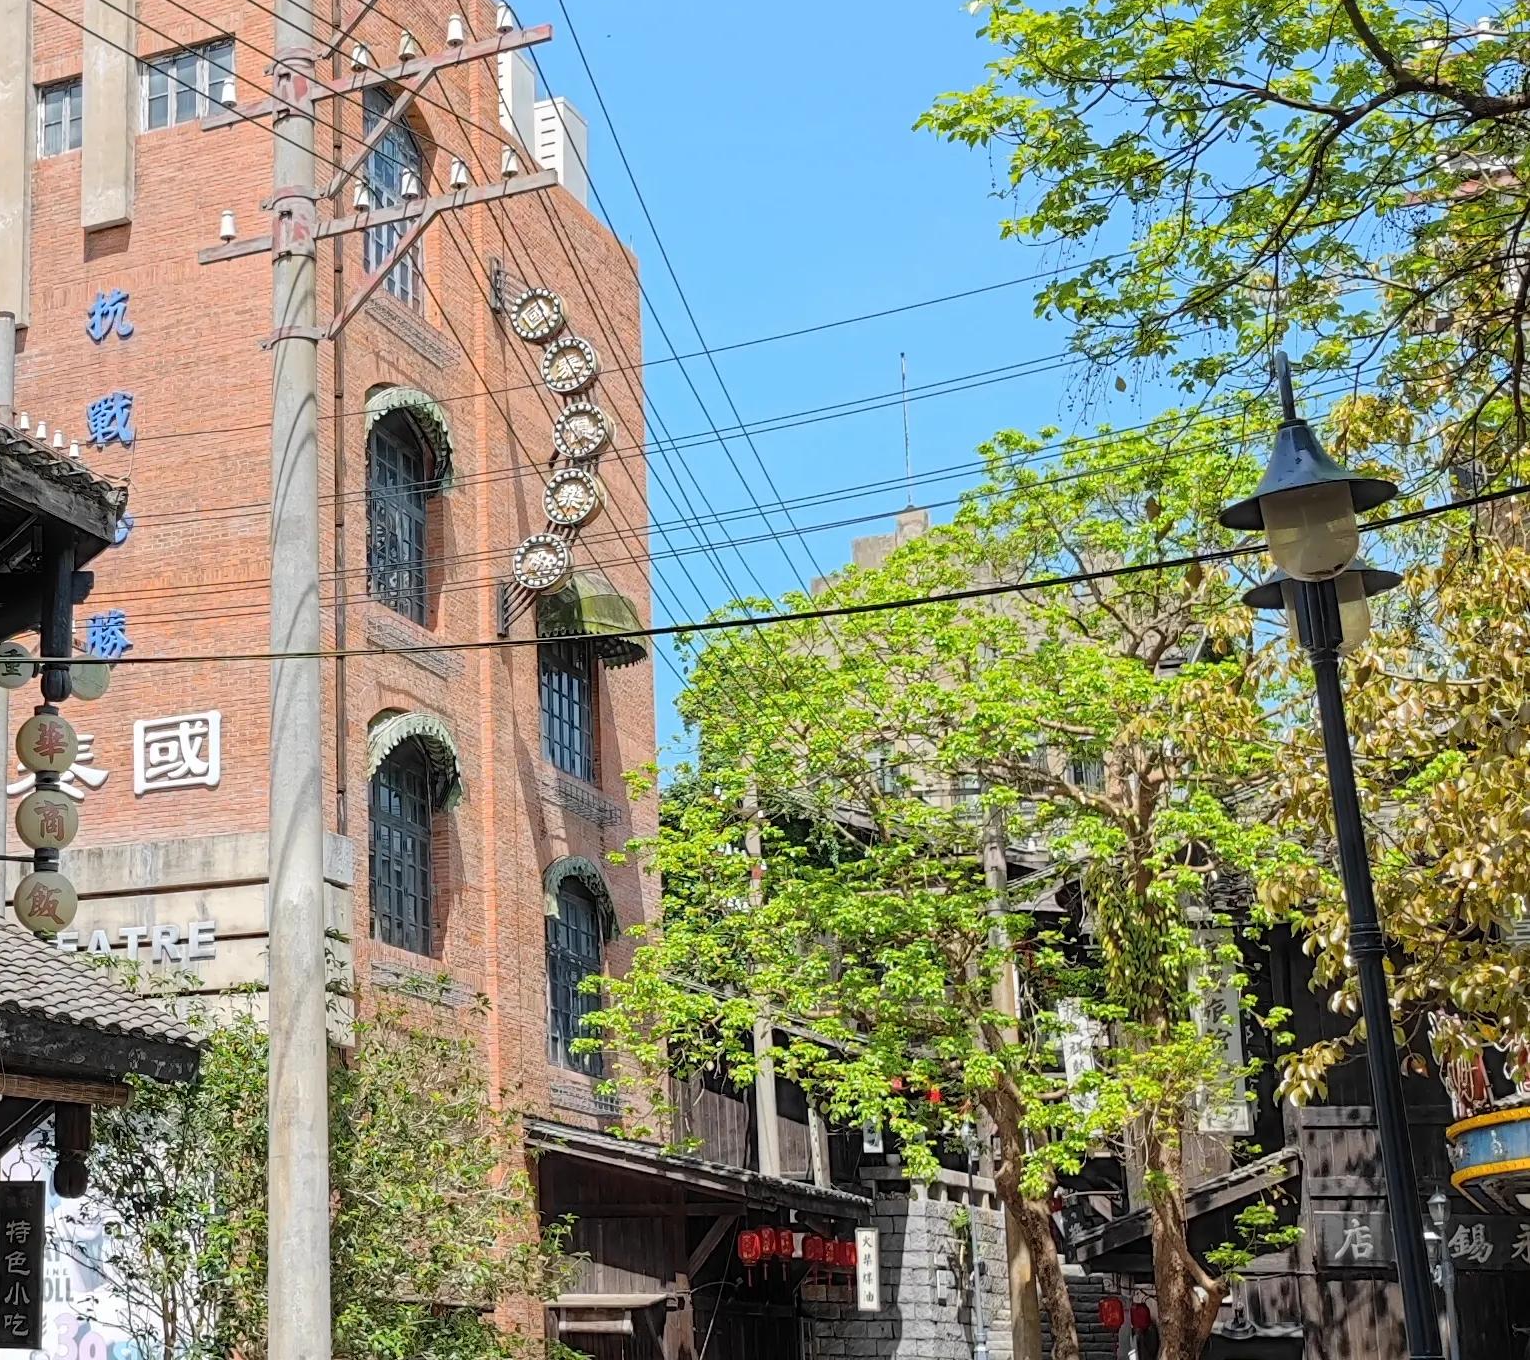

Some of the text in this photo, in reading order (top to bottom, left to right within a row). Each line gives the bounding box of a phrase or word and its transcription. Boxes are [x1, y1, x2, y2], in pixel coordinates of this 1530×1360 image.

[86, 289, 134, 660] 抗戰勝
[3, 1220, 32, 1338] 特色小吃
